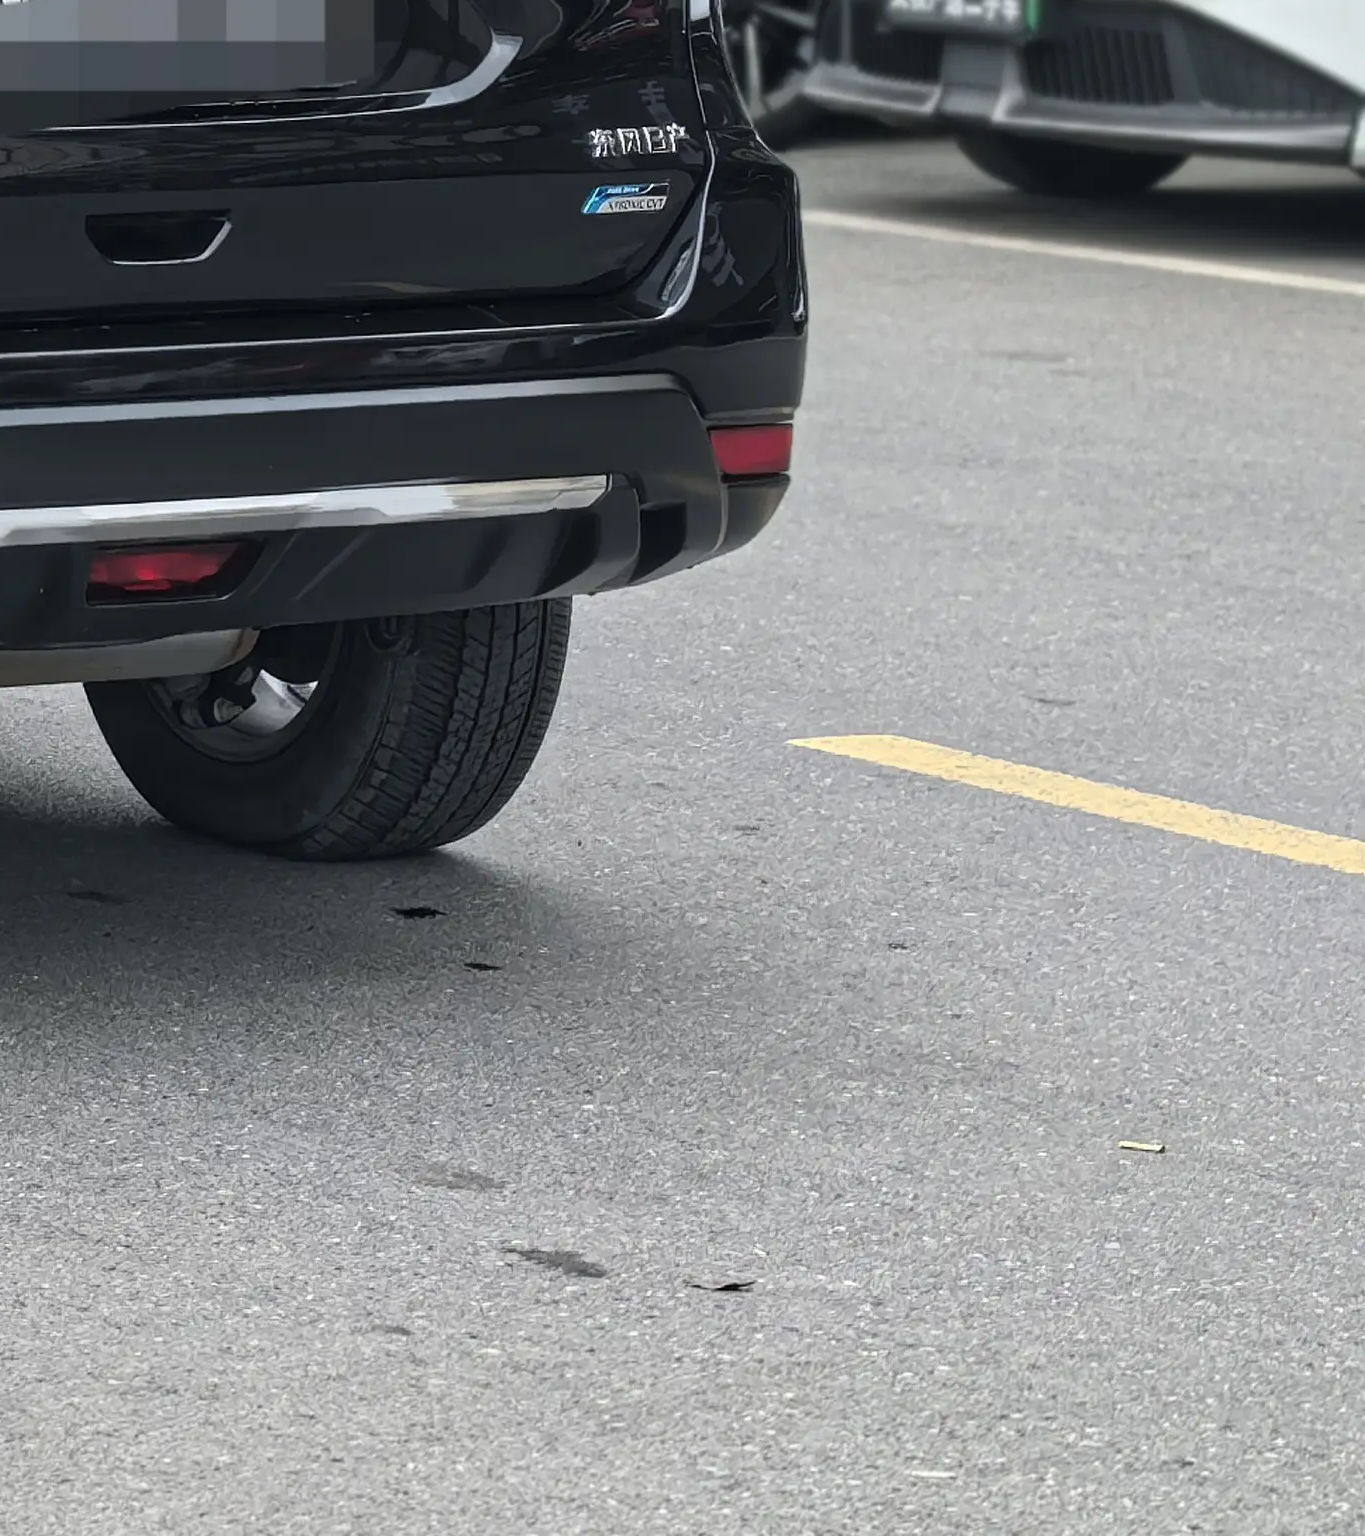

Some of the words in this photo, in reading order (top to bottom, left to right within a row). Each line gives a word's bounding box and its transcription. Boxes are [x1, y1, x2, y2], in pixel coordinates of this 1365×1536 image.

[588, 122, 690, 158] 东风日产
[646, 197, 664, 210] CVT
